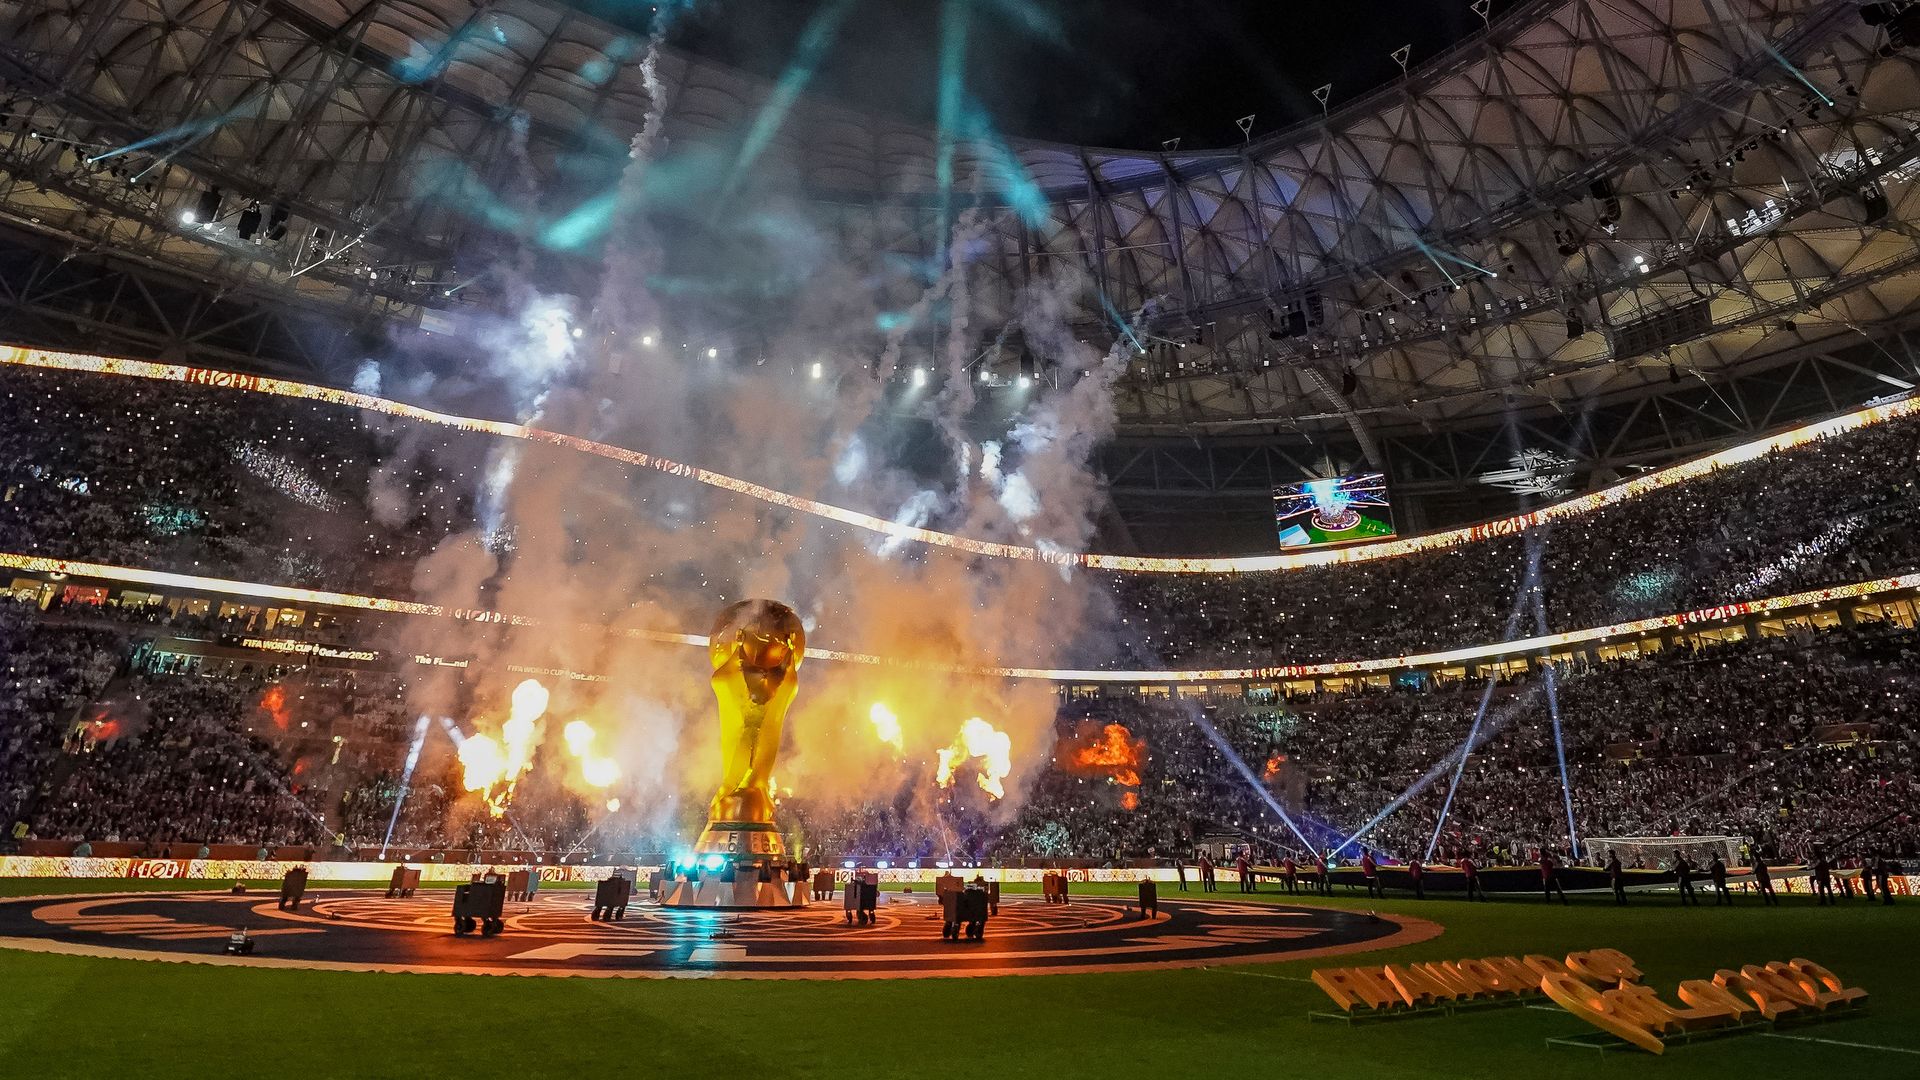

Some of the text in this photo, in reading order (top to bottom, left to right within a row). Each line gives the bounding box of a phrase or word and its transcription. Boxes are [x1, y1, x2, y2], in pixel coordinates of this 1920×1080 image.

[242, 639, 262, 648] FIFA
[263, 640, 295, 651] WORLD
[295, 644, 312, 653] CUP
[415, 655, 431, 665] The
